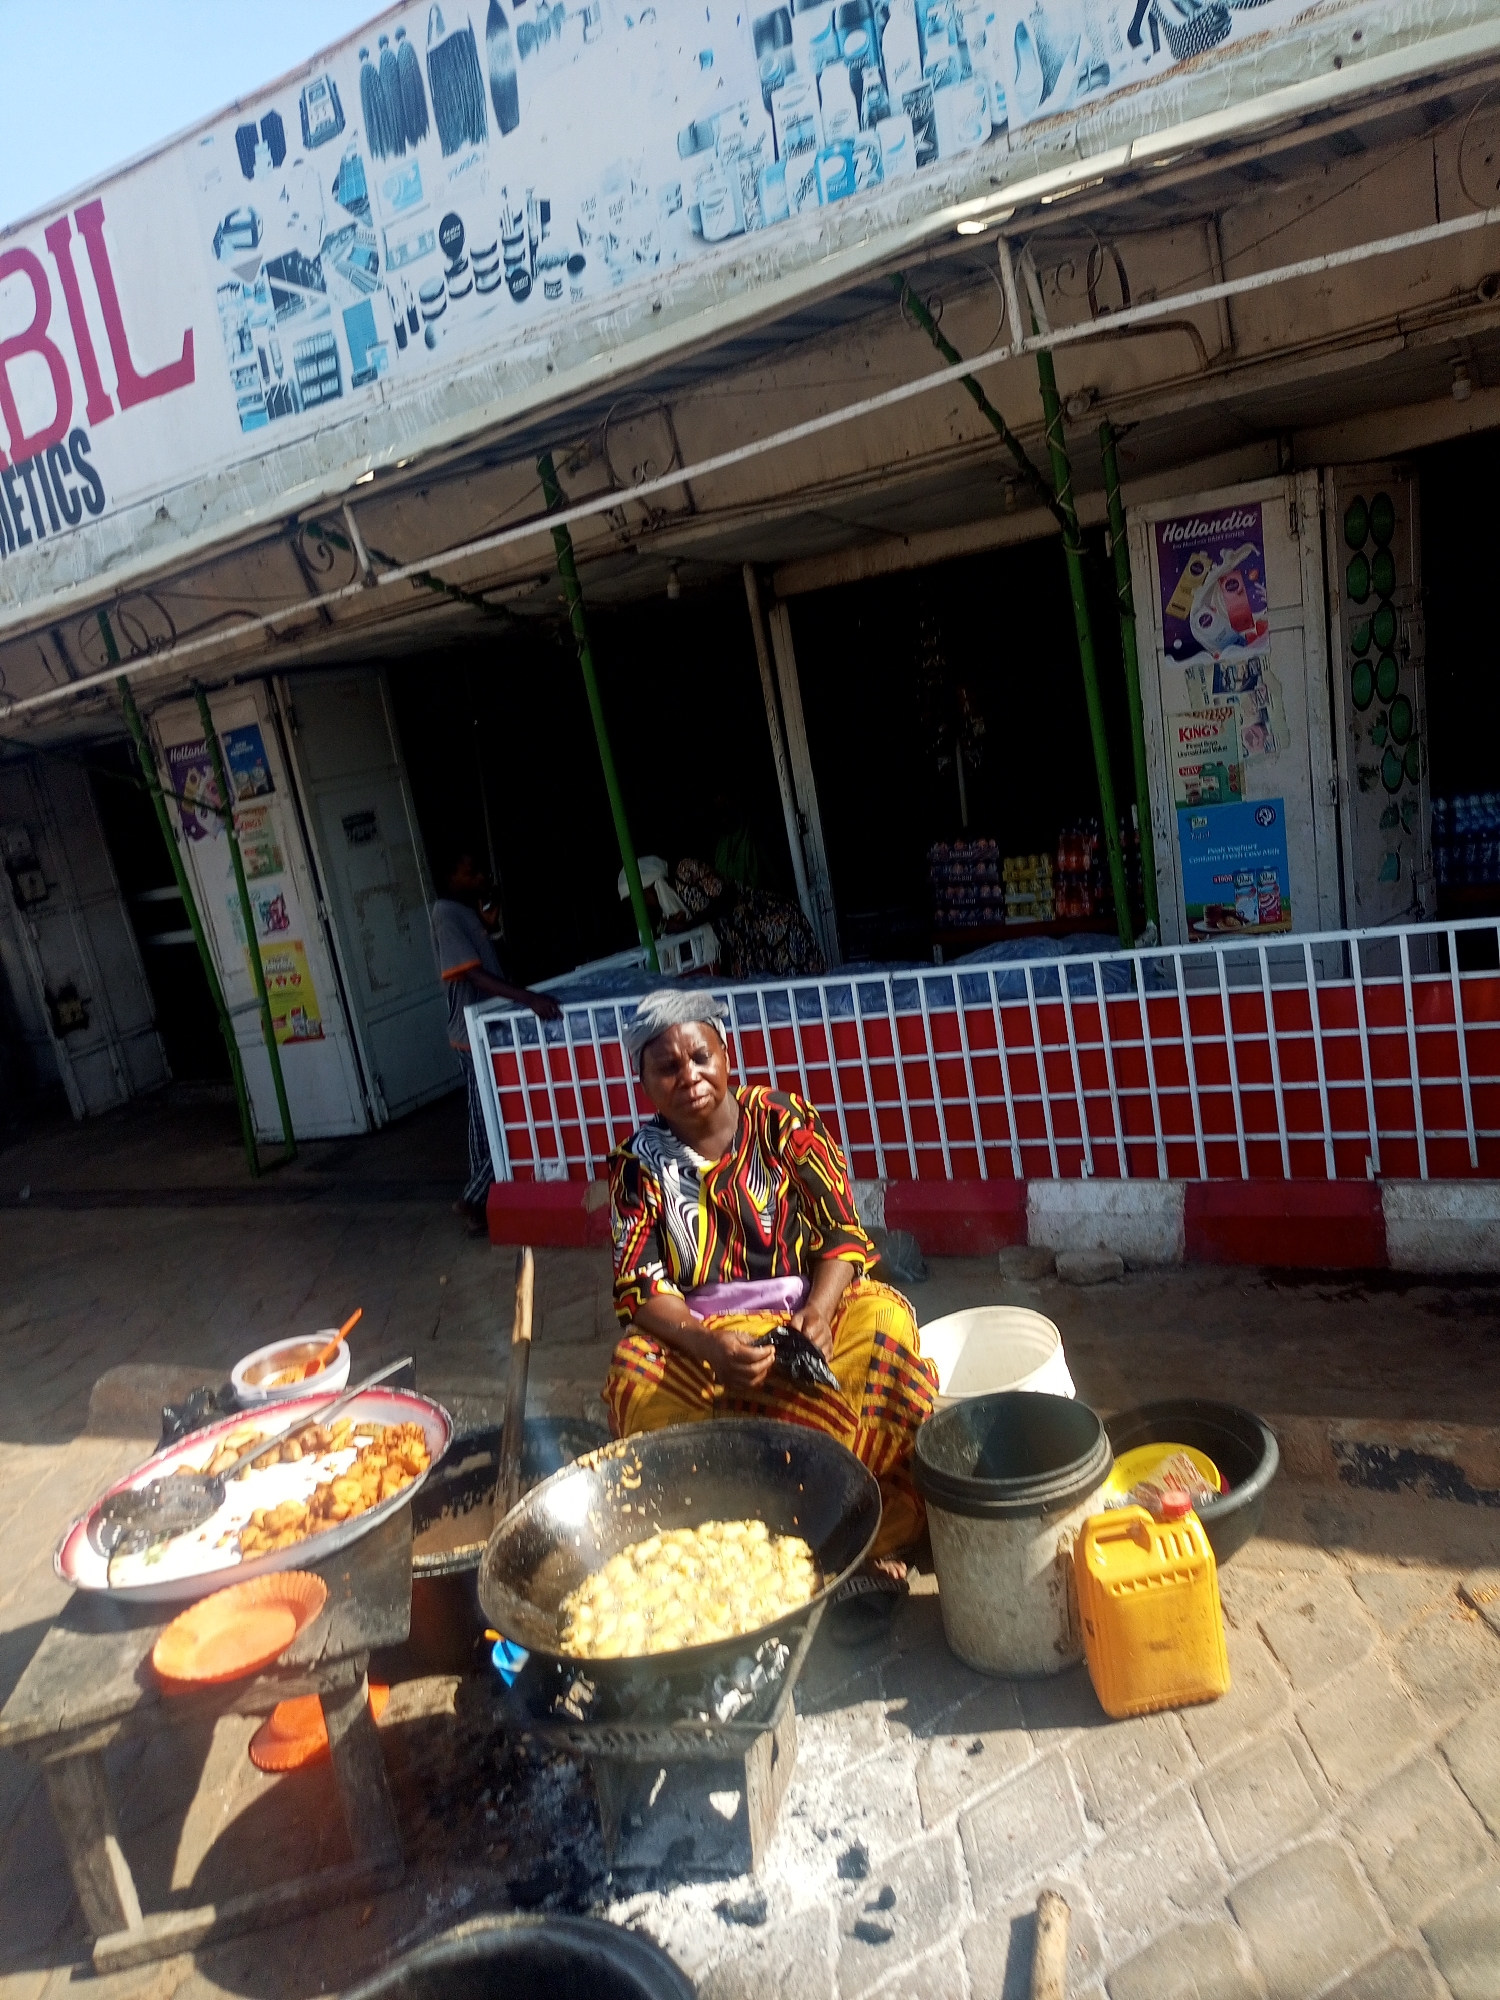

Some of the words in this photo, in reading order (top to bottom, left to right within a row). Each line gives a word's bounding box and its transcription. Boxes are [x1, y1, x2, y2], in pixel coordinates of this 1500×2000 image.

[0, 198, 196, 472] BIL
[1162, 510, 1256, 544] Hollandia
[1179, 725, 1219, 743] KING'S
[170, 740, 209, 763] Holland
